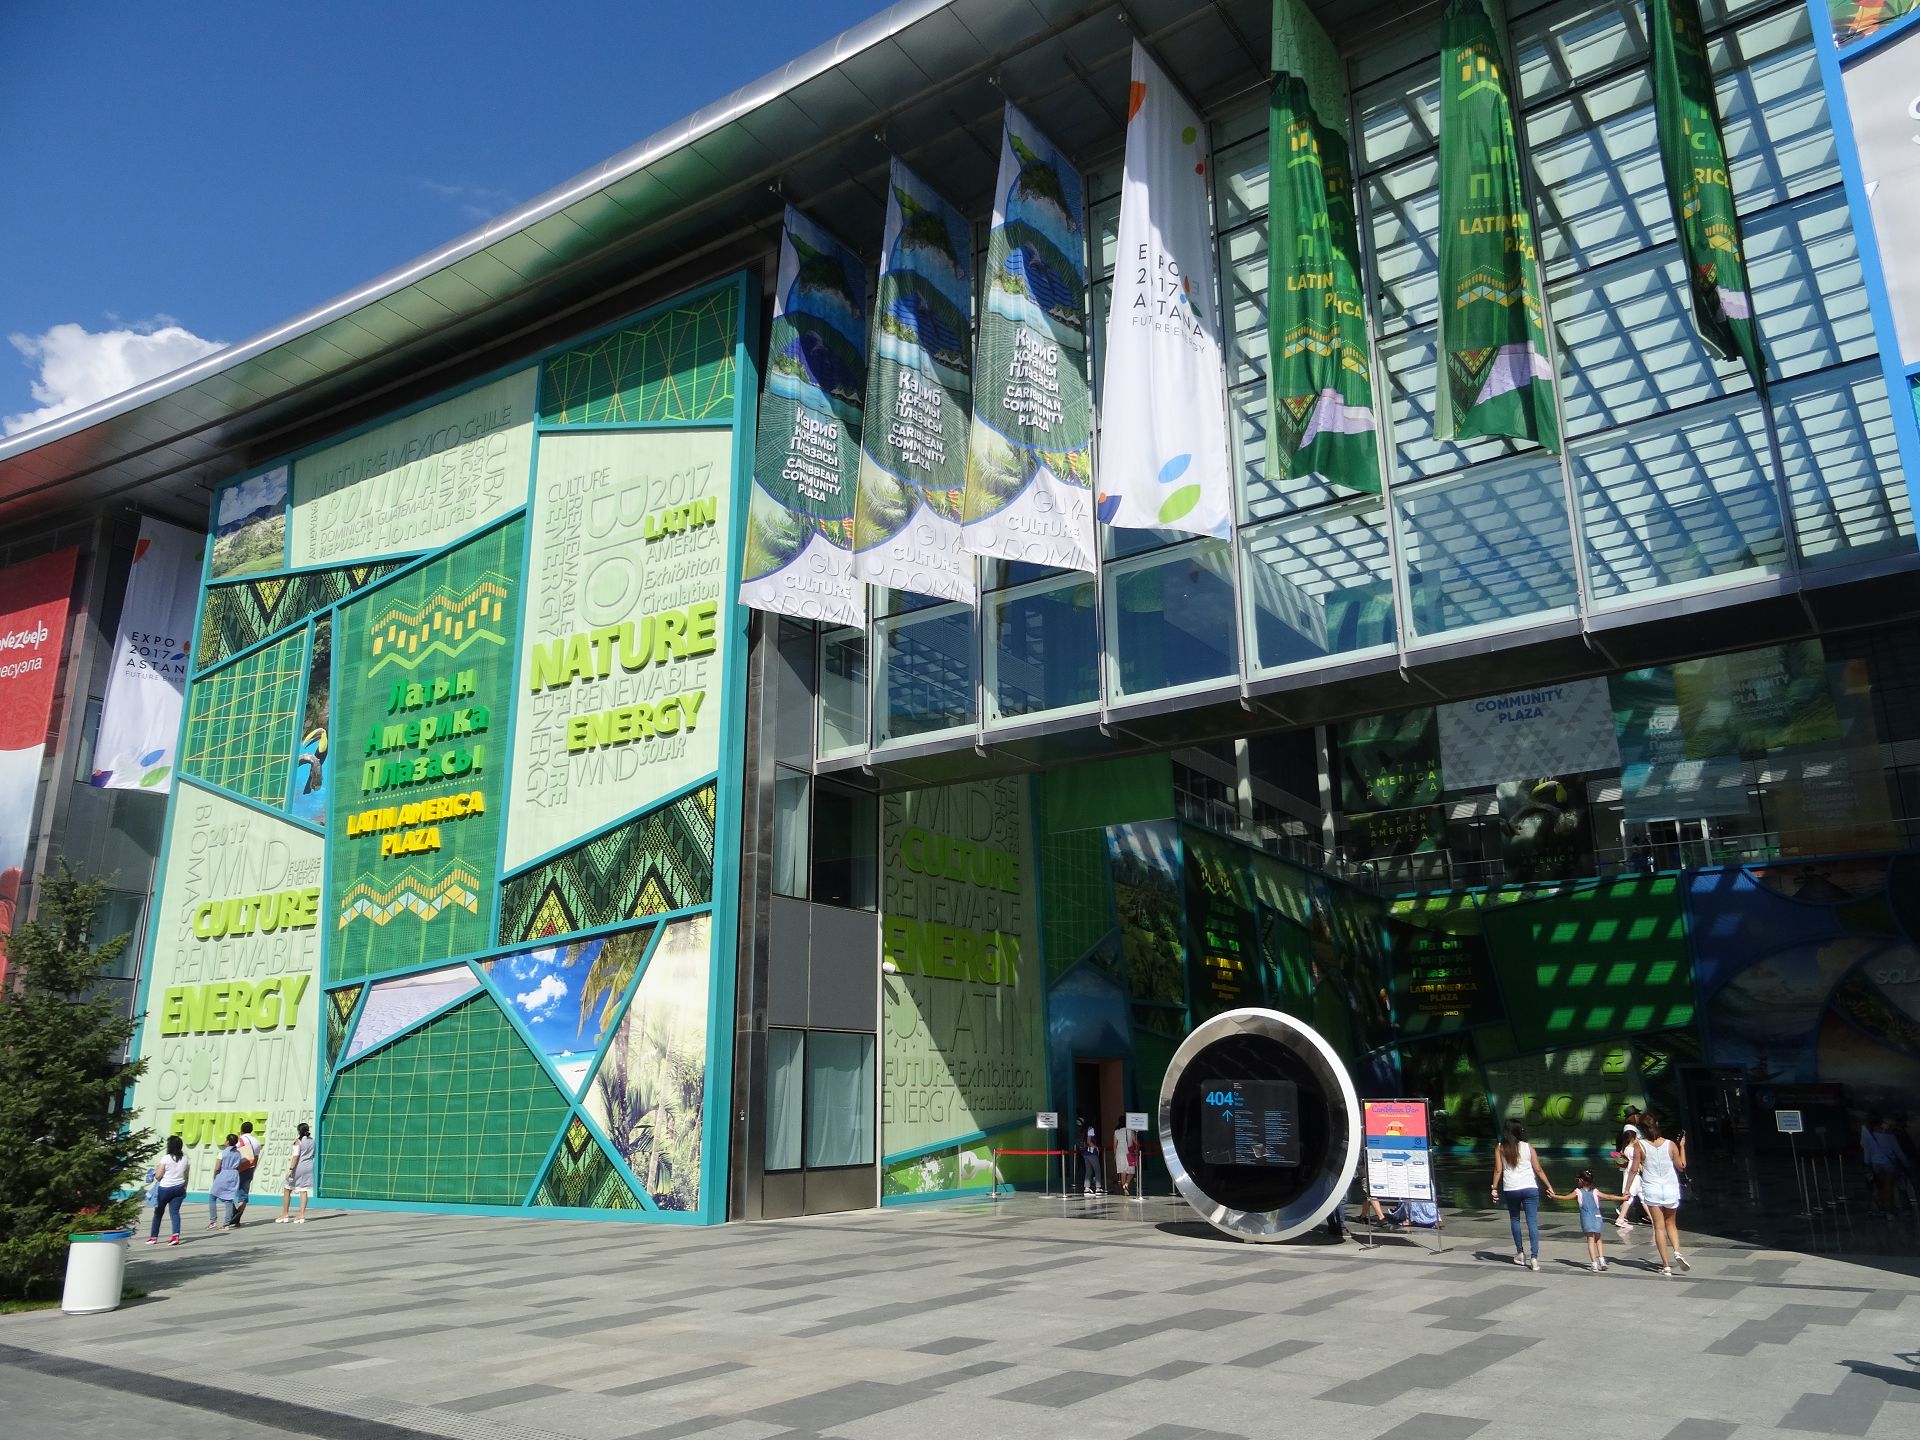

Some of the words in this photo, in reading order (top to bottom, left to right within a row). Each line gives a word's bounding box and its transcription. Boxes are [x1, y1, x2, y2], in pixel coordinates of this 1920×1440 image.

[1003, 399, 1063, 424] COMMUNITY
[1006, 385, 1060, 412] CARIBBEAN
[390, 424, 461, 468] MEXICO
[463, 405, 512, 440] CHILE
[892, 423, 943, 452] CARIBBEAN
[1019, 415, 1050, 433] PLAZA
[888, 434, 945, 465] COMMUNITY
[902, 451, 931, 471] PLAZA
[480, 432, 508, 515] CUBA
[548, 467, 612, 504] CULTURE
[648, 461, 714, 511] 2017
[782, 469, 841, 496] COMMUNITY
[786, 457, 838, 485] CARIBBEAN
[797, 483, 826, 502] PLAZA
[374, 501, 478, 551] Honduras
[644, 496, 717, 545] LATIN
[1008, 517, 1080, 541] CULTURE
[645, 527, 720, 566] AMERICA
[894, 546, 960, 575] CULTURE
[644, 555, 721, 592] Exhibition
[784, 576, 852, 601] CULTURE
[641, 581, 720, 617] Circulation
[129, 644, 171, 660] 2017
[131, 631, 175, 648] EXPO
[530, 600, 717, 694] NATURE
[0, 657, 43, 679] есуэла
[125, 670, 160, 681] FUTURE
[126, 658, 185, 675] ASTAN
[387, 668, 477, 716] Латын
[573, 659, 708, 717] RENEWABLE
[1475, 689, 1563, 713] COMMUNITY
[365, 704, 491, 757] Америка
[567, 690, 706, 757] ENERGY
[1498, 706, 1544, 723] PLAZA
[526, 694, 555, 809] ENERGY
[640, 736, 687, 768] SOLAR
[361, 744, 485, 795] Плазасы
[1366, 770, 1437, 789] AMERICA
[346, 805, 399, 839] LATIN
[399, 790, 485, 829] AMERICA
[208, 821, 251, 848] 2017
[380, 827, 442, 858] PLAZA
[177, 803, 213, 945] BIOMASS
[207, 839, 291, 901] WIND
[288, 856, 322, 875] FUTURE
[901, 826, 1022, 896] CULTURE
[286, 869, 321, 889] ENERGY
[193, 887, 322, 944] CULTURE
[883, 874, 1022, 939] RENEWABLE
[170, 930, 317, 985] RENEWABLE
[883, 914, 1022, 989] ENERGY
[160, 974, 312, 1039] ENERGY
[216, 1032, 315, 1104] LATIN
[881, 1058, 956, 1089] FUTURE
[957, 1060, 1034, 1089] Exhibition
[881, 1089, 956, 1125] ENERGY
[958, 1090, 1034, 1113] Circulation
[1205, 1091, 1234, 1106] 404
